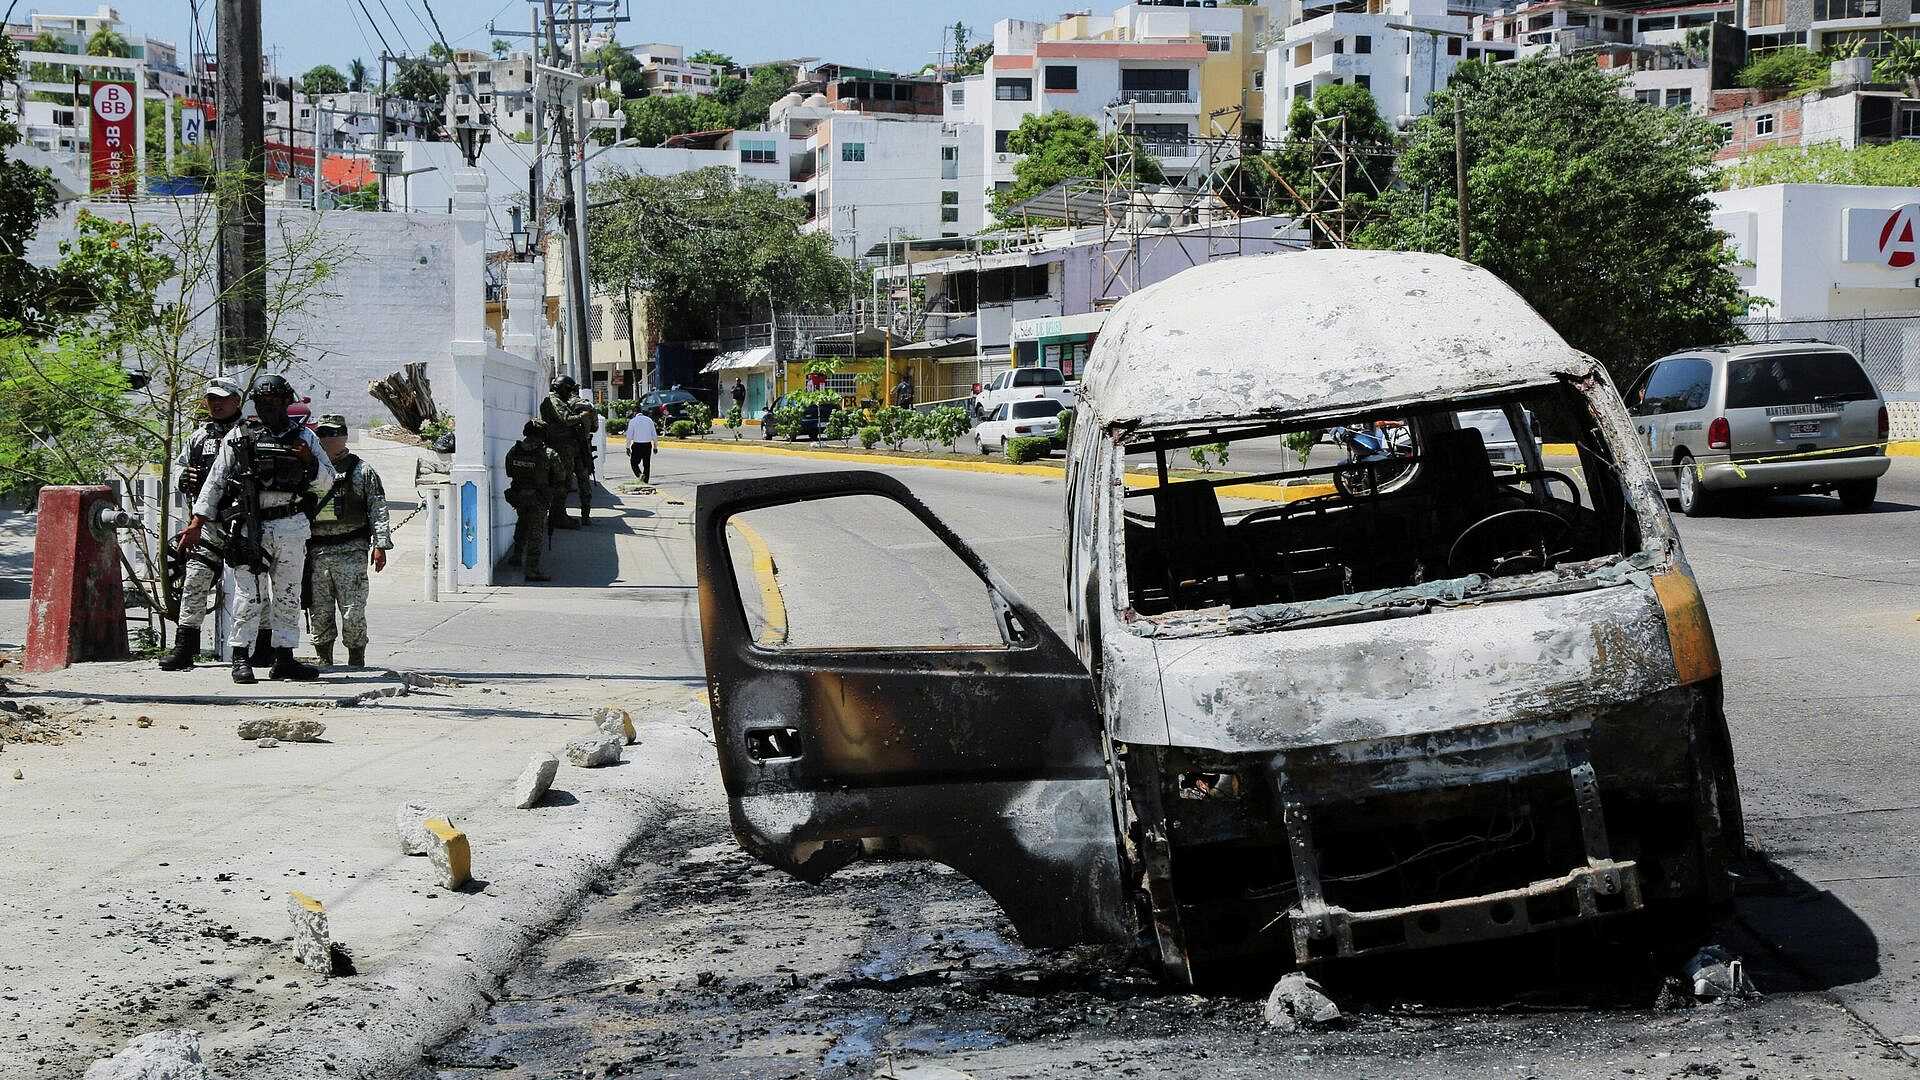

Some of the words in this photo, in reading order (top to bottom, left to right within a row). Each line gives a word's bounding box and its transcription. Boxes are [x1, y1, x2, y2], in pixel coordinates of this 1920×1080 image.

[108, 88, 119, 100] B
[101, 101, 126, 114] BB
[106, 126, 120, 148] 3B
[1765, 404, 1814, 416] MANTENIMIENTO
